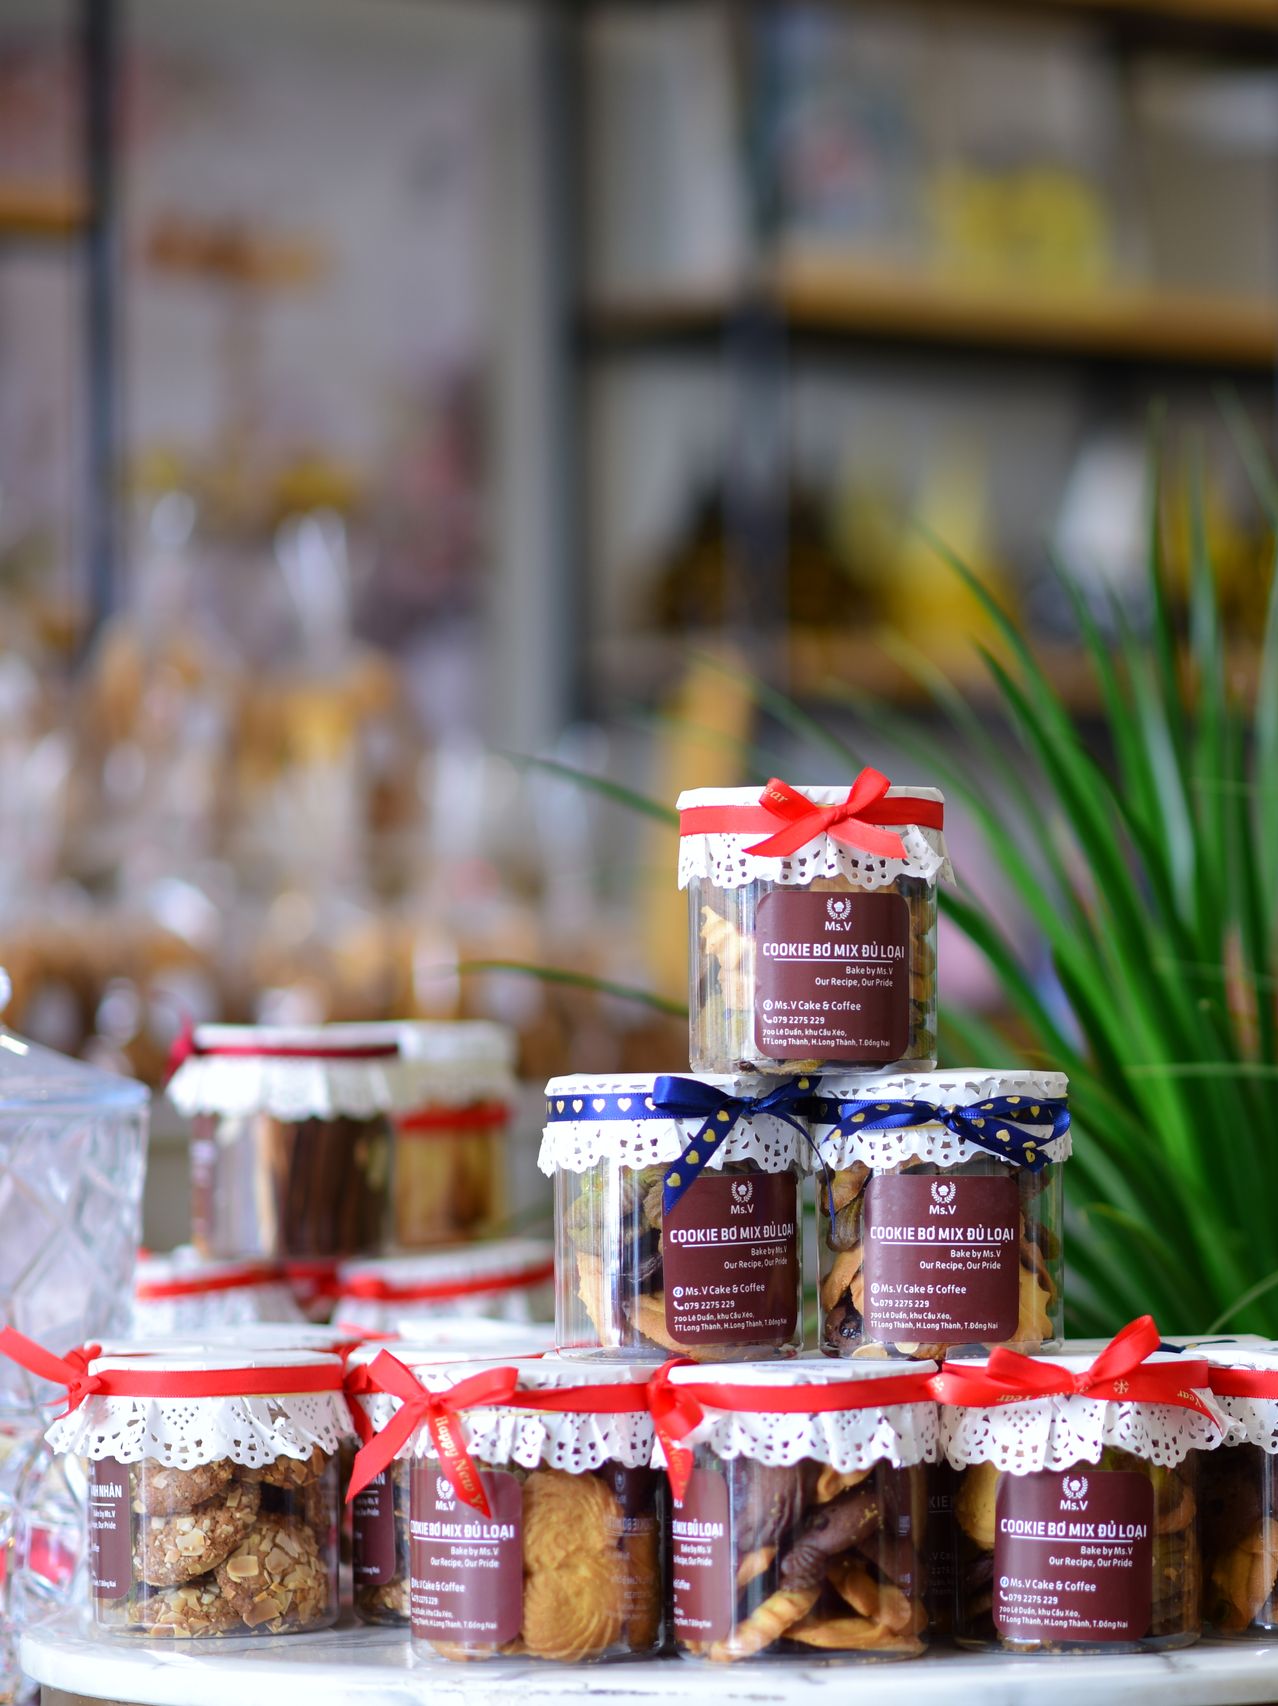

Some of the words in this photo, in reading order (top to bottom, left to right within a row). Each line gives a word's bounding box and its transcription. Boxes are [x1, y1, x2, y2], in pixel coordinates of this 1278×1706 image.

[825, 922, 851, 931] Ms.V
[763, 943, 810, 956] COOKIE
[835, 945, 858, 957] MIX
[862, 941, 877, 957] ĐỦ
[881, 946, 904, 960] LOẠI
[846, 966, 864, 974] Bake
[866, 967, 875, 976] by
[831, 978, 860, 987] Recipe,
[876, 979, 893, 987] Pride
[775, 1001, 797, 1009] Ms.V
[799, 1001, 820, 1009] Cake
[822, 1001, 829, 1010] &
[832, 1002, 861, 1010] Coffee
[771, 1038, 787, 1046] Long
[731, 1204, 754, 1214] Ms.V
[929, 1205, 956, 1214] Ms.V
[670, 1229, 718, 1242] COOKIE
[740, 1226, 760, 1238] MIX
[763, 1221, 776, 1237] ĐỦ
[778, 1223, 793, 1237] LOẠI
[871, 1226, 914, 1240] COOKIE
[939, 1228, 963, 1240] MIX
[967, 1224, 984, 1240] ĐỦ
[988, 1228, 1013, 1243] LOẠI
[751, 1248, 766, 1256] Bake
[951, 1250, 970, 1258] Bake
[972, 1250, 981, 1259] by
[983, 1250, 1001, 1258] Ms.V
[724, 1261, 737, 1269] Our
[739, 1259, 763, 1268] Recipe,
[920, 1261, 934, 1269] Our
[936, 1261, 965, 1271] Recipe,
[686, 1287, 708, 1296] Ms.V
[710, 1286, 730, 1294] Cake
[740, 1284, 765, 1292] Coffee
[881, 1284, 902, 1292] Ms.V
[904, 1284, 925, 1293] Cake
[936, 1285, 966, 1294] Coffee
[684, 1302, 699, 1310] 079
[701, 1301, 720, 1309] 2275
[878, 1322, 892, 1330] Long
[434, 1416, 459, 1458] Happy
[436, 1501, 456, 1511] Ms.V
[1060, 1500, 1088, 1510] Ms.V
[442, 1524, 462, 1537] MIX
[485, 1525, 514, 1541] LOẠI
[700, 1523, 722, 1538] LOẠI
[1001, 1519, 1045, 1534] COOKIE
[1069, 1523, 1094, 1537] MIX
[1098, 1520, 1115, 1537] ĐỦ
[1119, 1524, 1146, 1540] LOẠI
[451, 1547, 467, 1555] Bake
[468, 1547, 478, 1556] by
[479, 1548, 498, 1556] Ms.V
[1081, 1546, 1101, 1554] Bake
[1102, 1547, 1112, 1556] by
[1114, 1547, 1133, 1555] Ms.V
[431, 1557, 440, 1566] Our
[479, 1560, 498, 1568] Pride
[1049, 1556, 1063, 1565] Our
[1065, 1557, 1095, 1568] Recipe,
[1097, 1559, 1111, 1567] Our
[1113, 1559, 1132, 1567] Pride
[441, 1583, 465, 1592] Coffee
[1010, 1579, 1031, 1587] Ms.V
[1032, 1580, 1054, 1589] Cake
[1065, 1581, 1096, 1591] Coffee
[1023, 1595, 1041, 1603] 2275
[1043, 1596, 1058, 1604] 229
